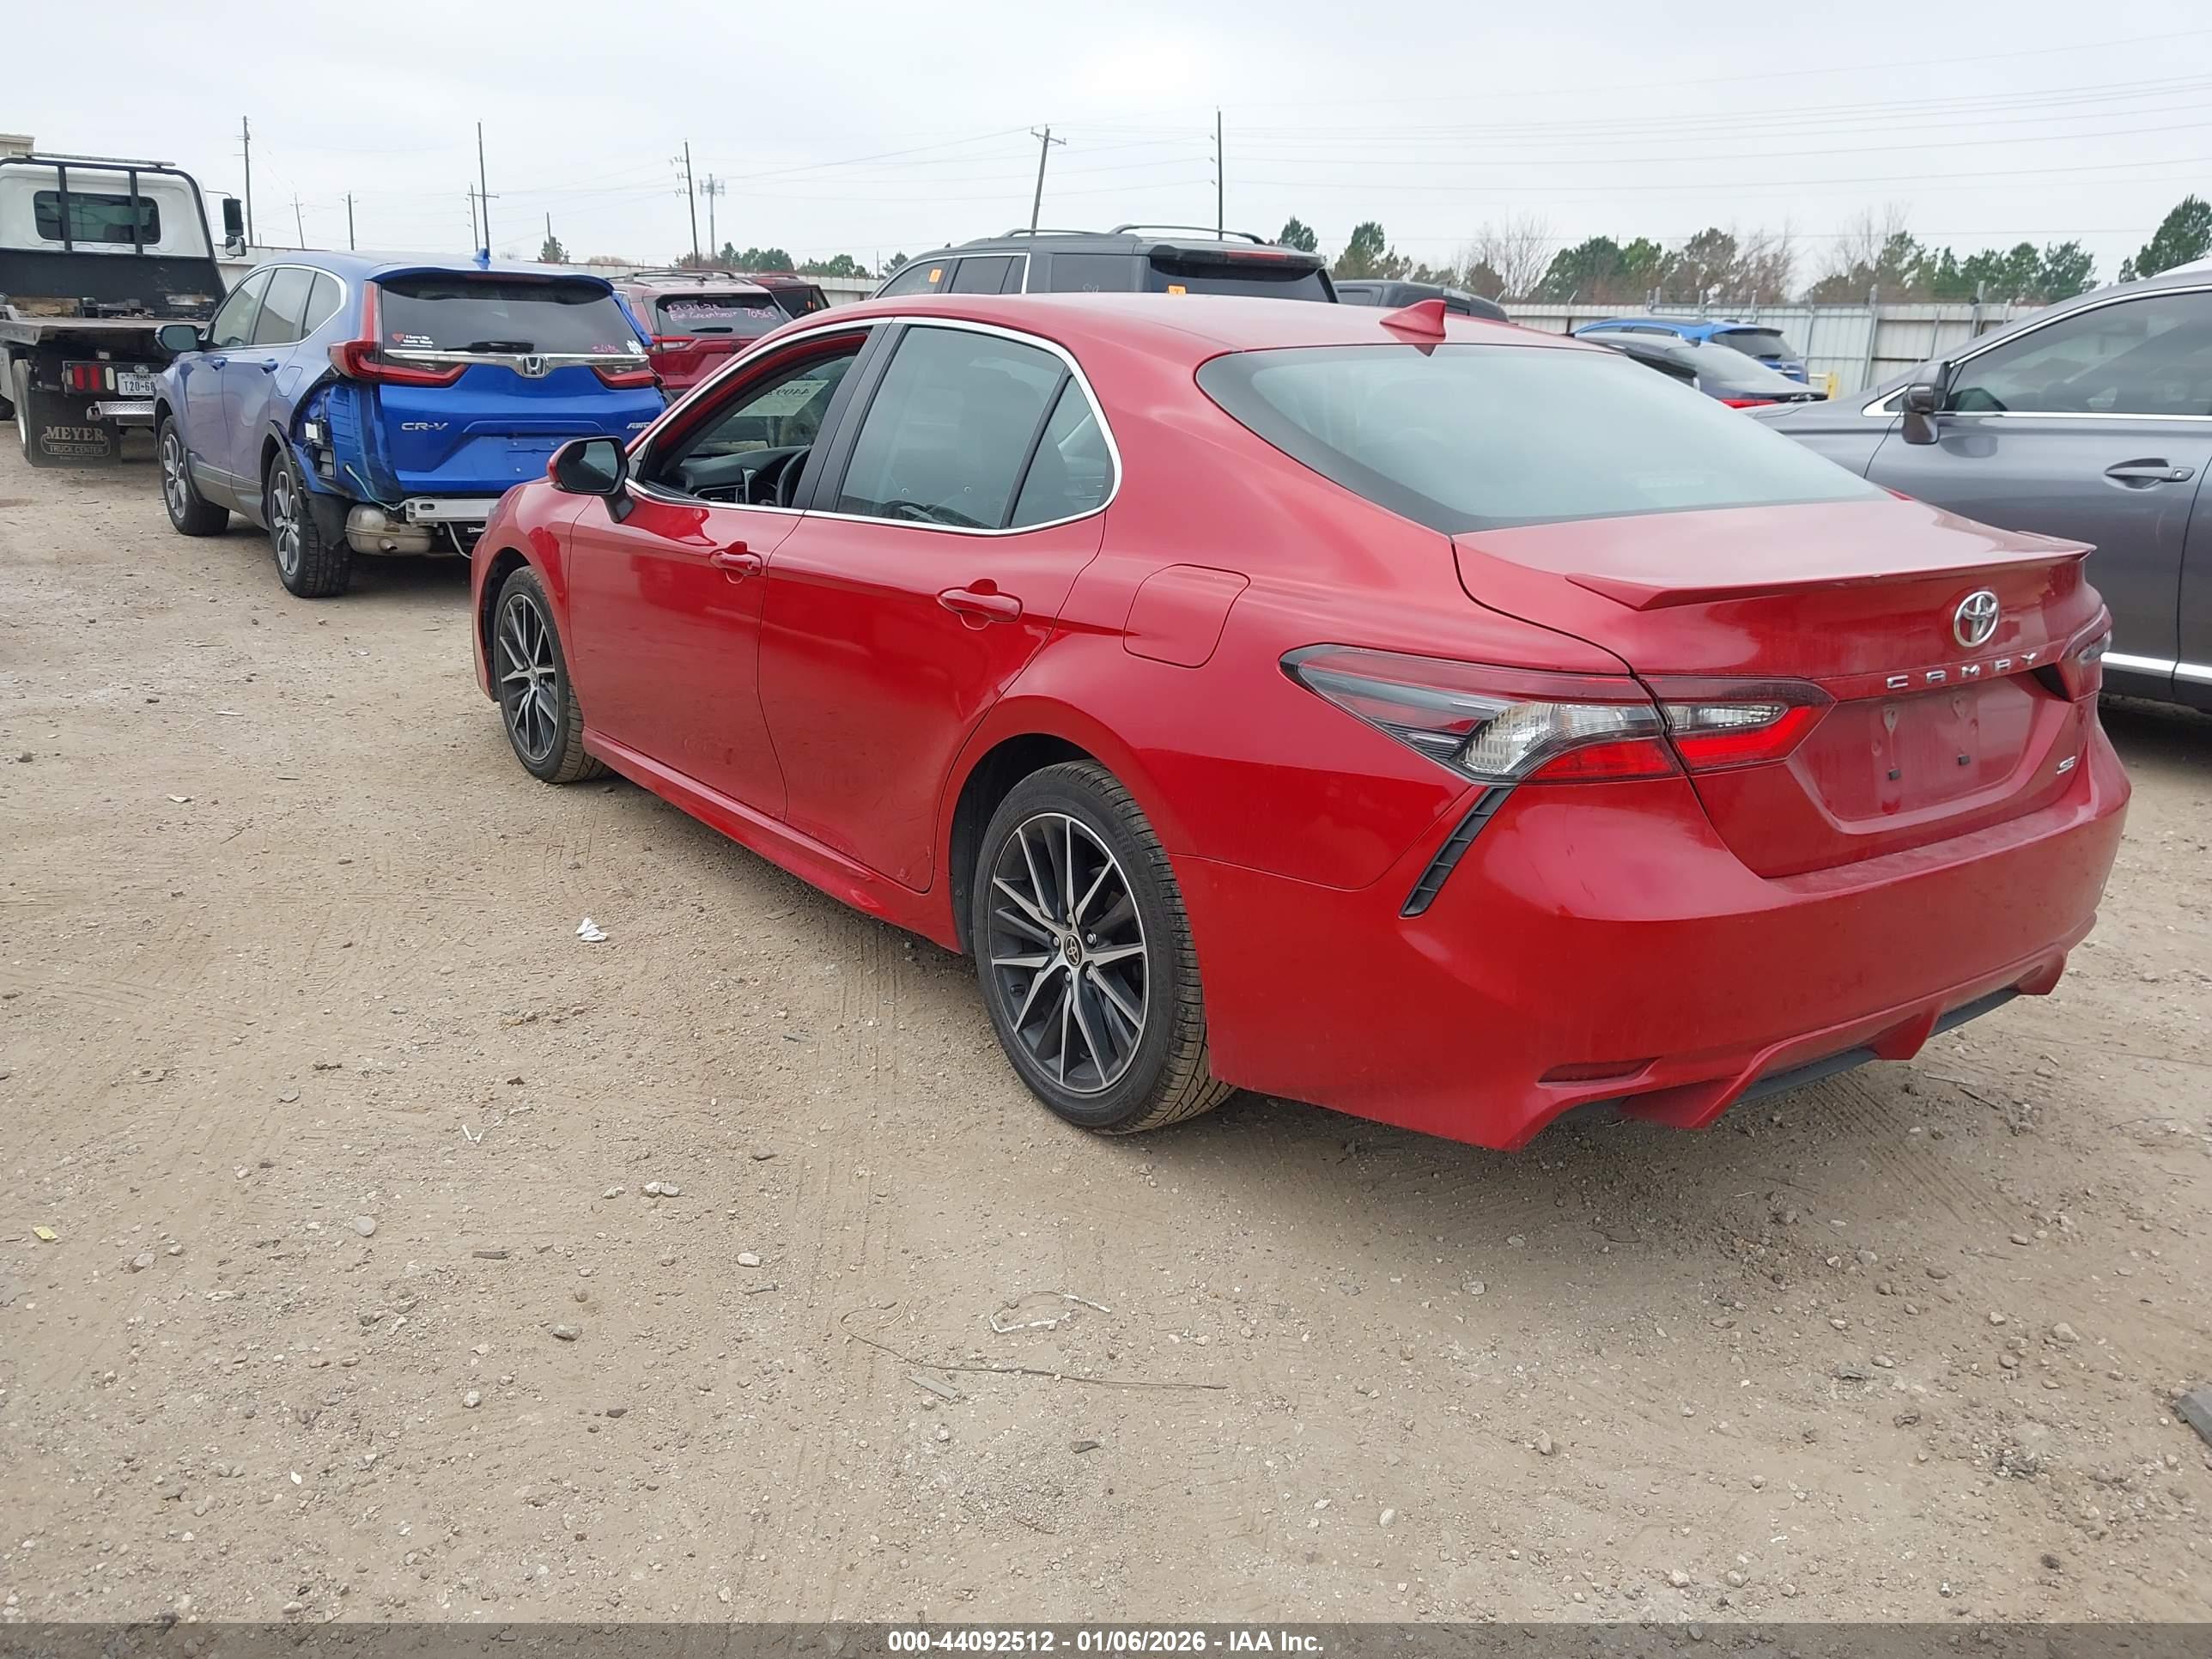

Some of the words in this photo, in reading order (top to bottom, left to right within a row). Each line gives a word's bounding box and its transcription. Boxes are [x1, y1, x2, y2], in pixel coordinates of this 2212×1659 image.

[45, 425, 104, 441] MEYER
[401, 422, 448, 431] CR-V
[50, 445, 74, 454] TRUCK
[75, 446, 104, 455] CENTER
[1886, 652, 2038, 689] CAMRY
[2056, 755, 2076, 775] SE
